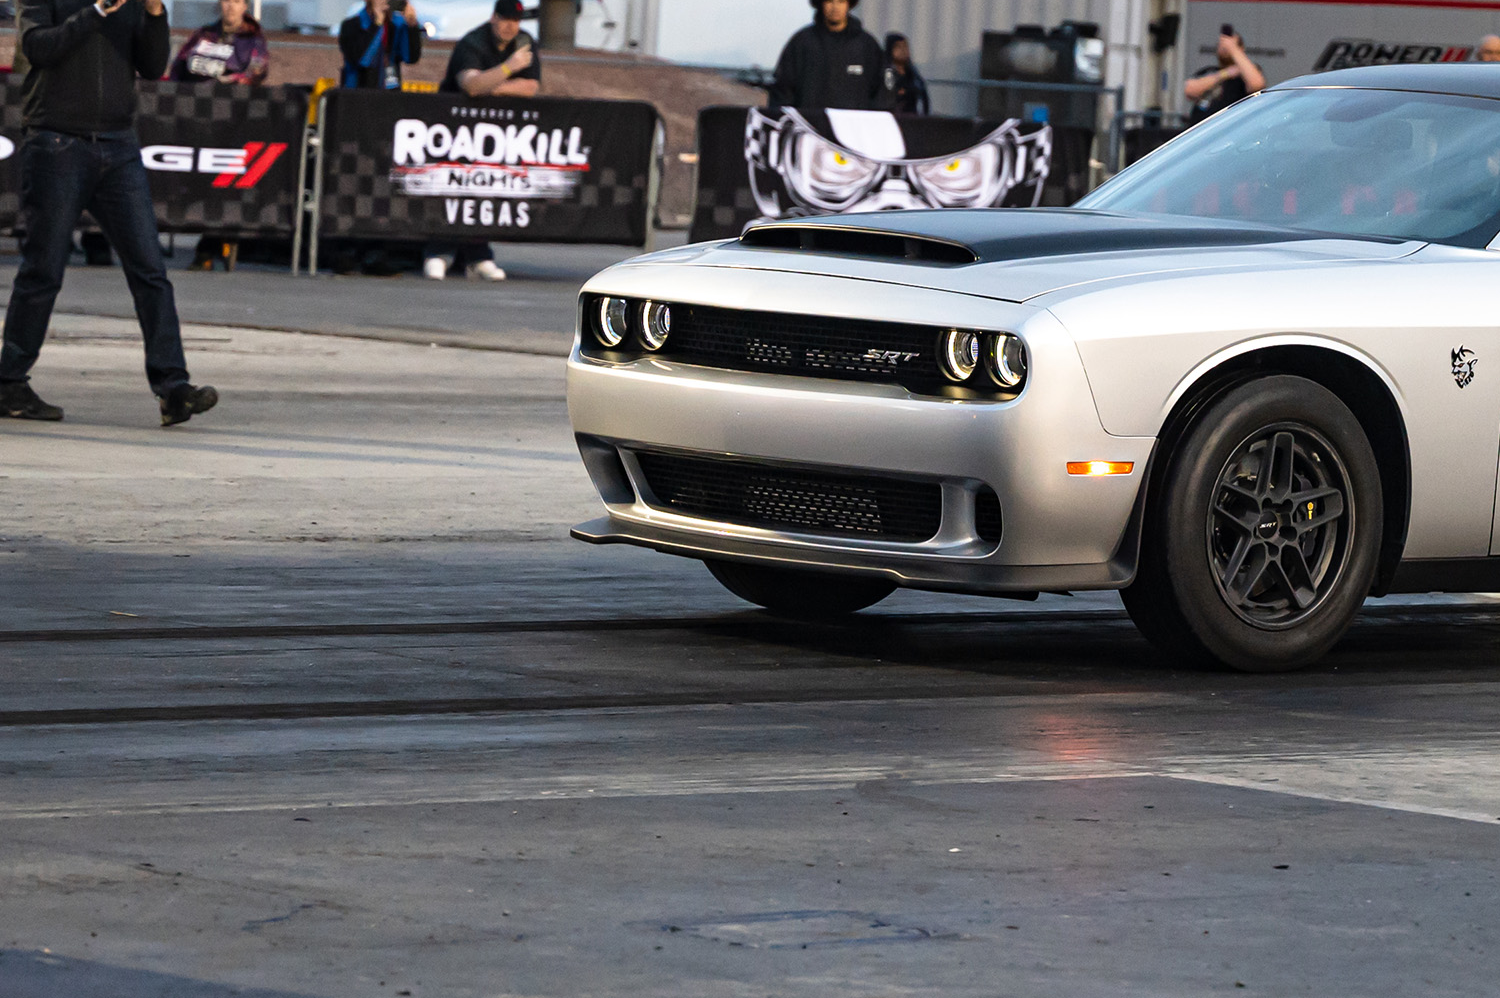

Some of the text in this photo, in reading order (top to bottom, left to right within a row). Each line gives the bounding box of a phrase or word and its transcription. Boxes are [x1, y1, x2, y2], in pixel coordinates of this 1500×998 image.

[1312, 41, 1442, 71] POWER
[393, 118, 587, 165] ROADKILL
[445, 198, 531, 228] VEGAS
[863, 348, 920, 365] SRT
